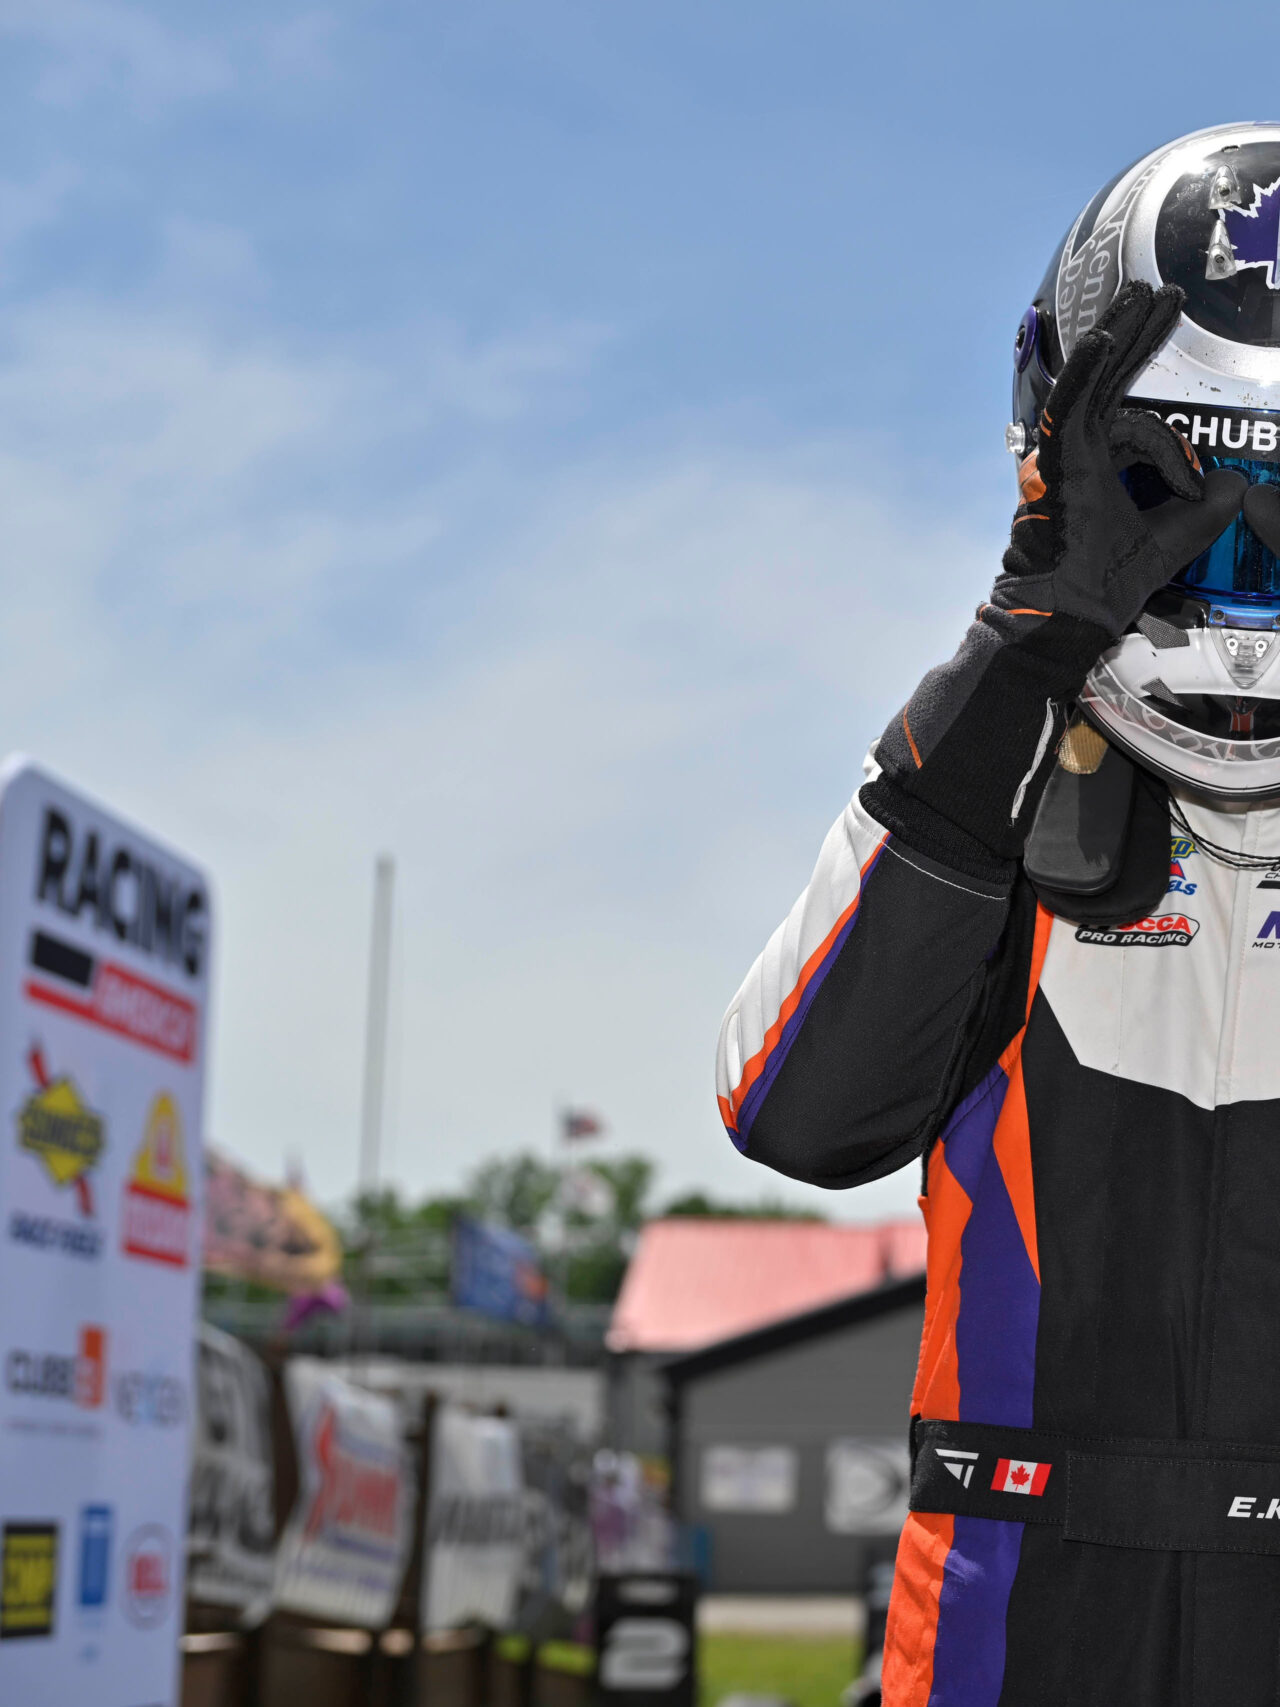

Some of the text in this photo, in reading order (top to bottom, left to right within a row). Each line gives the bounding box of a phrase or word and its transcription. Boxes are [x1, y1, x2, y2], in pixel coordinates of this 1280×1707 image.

[36, 806, 212, 979] RACING
[1166, 879, 1198, 896] ELS
[1078, 930, 1189, 945] PRO RACING
[600, 1616, 690, 1692] 2
